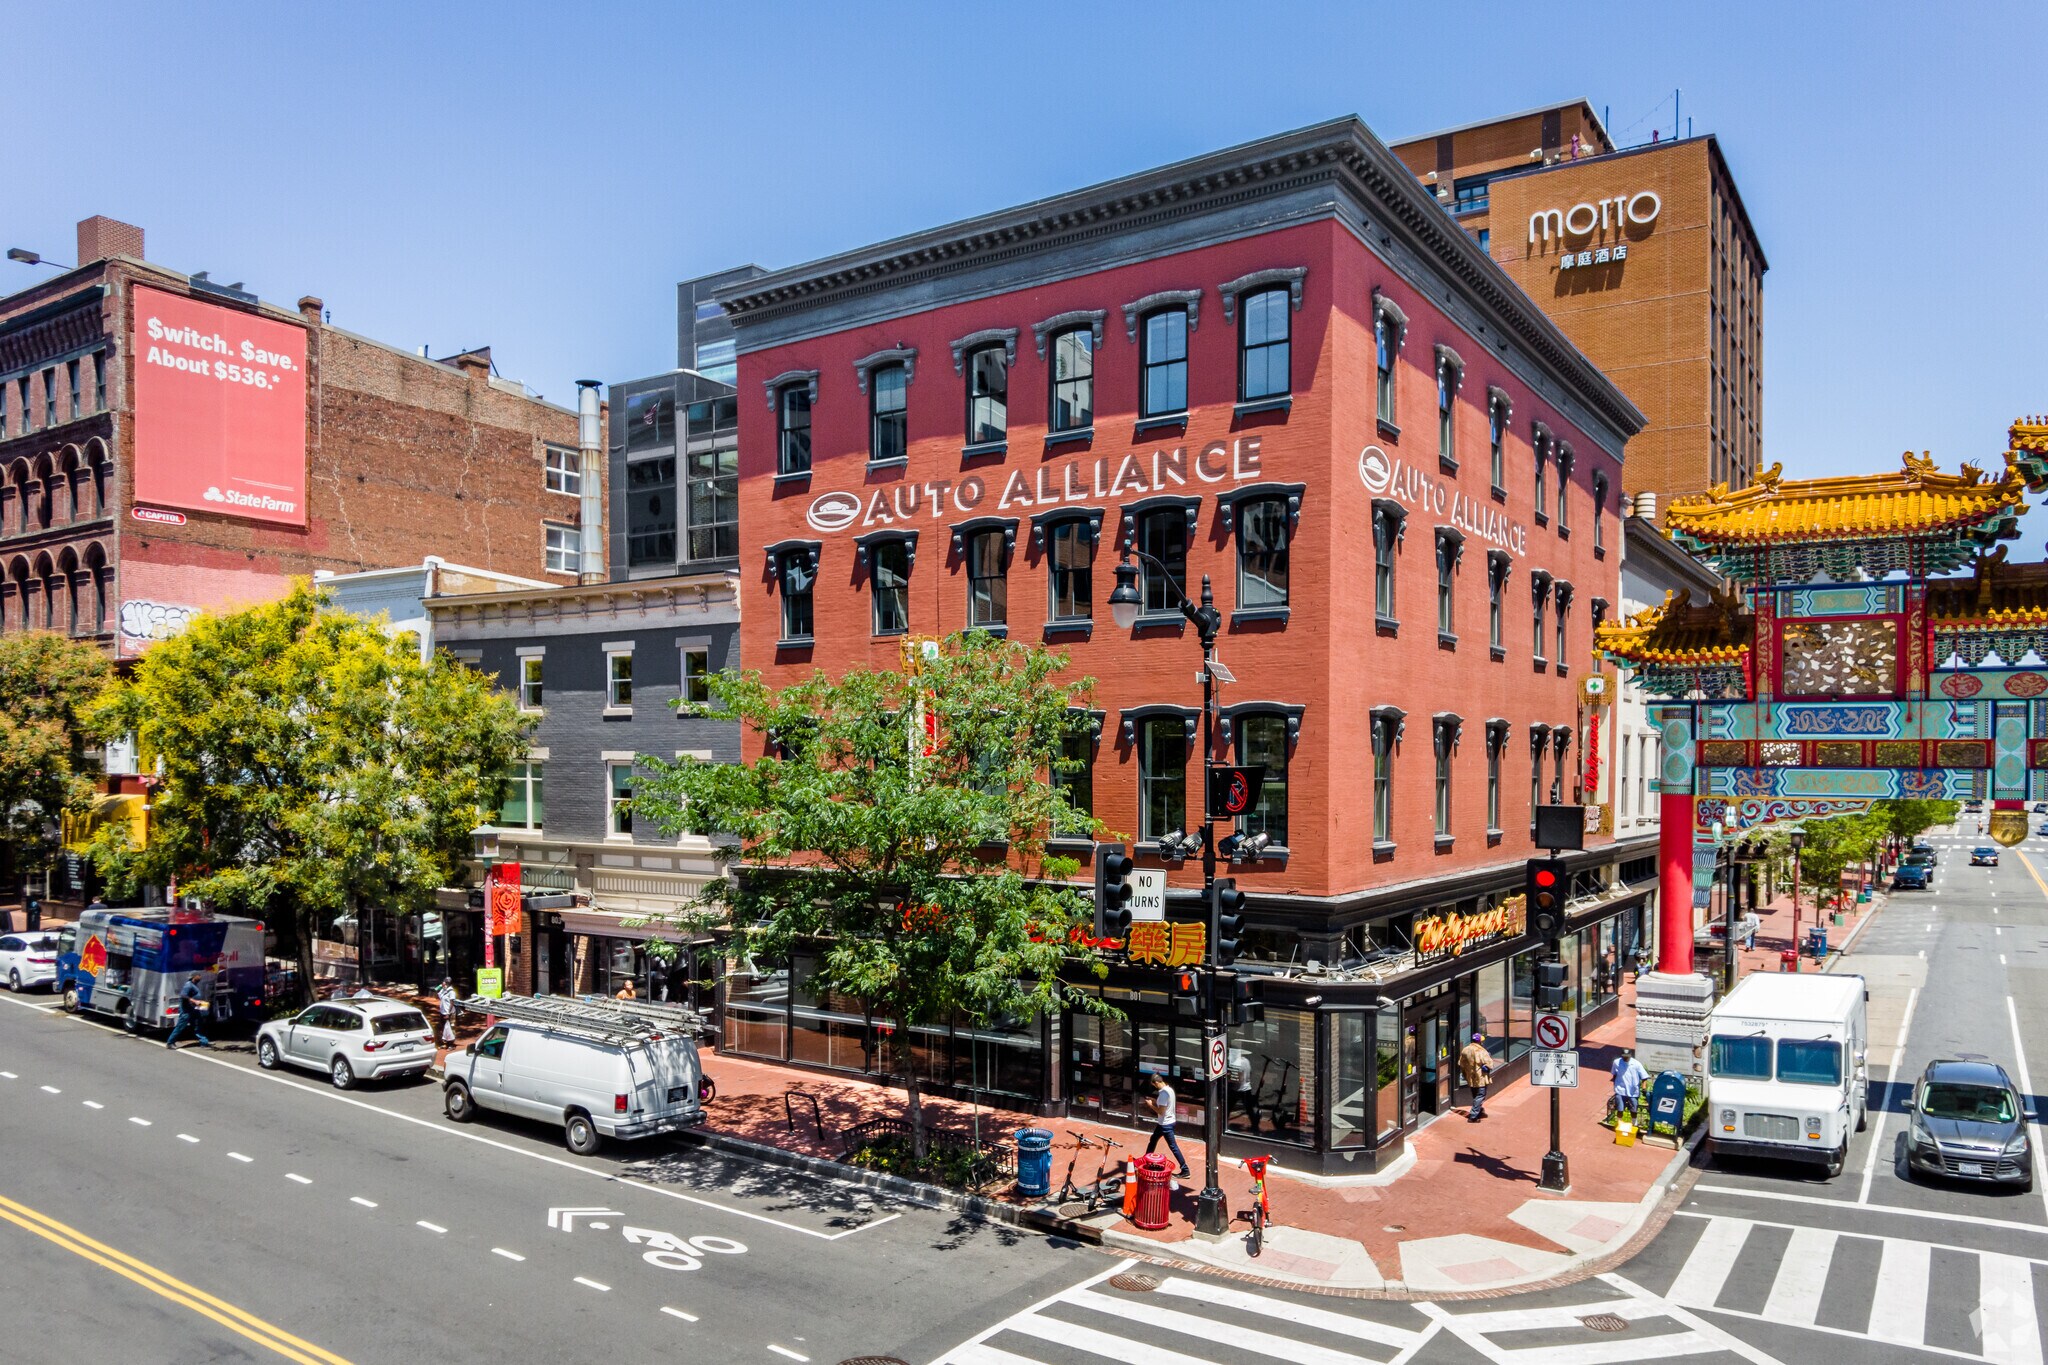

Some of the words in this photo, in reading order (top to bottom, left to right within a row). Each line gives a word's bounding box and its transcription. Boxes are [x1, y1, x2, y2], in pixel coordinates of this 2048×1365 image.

[1529, 191, 1661, 243] MOTTO
[1560, 245, 1627, 270] 摩庭酒店
[147, 316, 234, 356] $witch.
[240, 339, 298, 371] $ave.
[147, 346, 210, 376] About
[862, 475, 985, 527] AUTO
[997, 435, 1262, 509] ALLIANCE
[145, 510, 181, 523] CAPITOL
[1390, 459, 1447, 515] AUTO
[1450, 491, 1526, 557] ALLIANCE
[1584, 713, 1603, 792] Walgreens
[1138, 875, 1152, 888] NO
[1129, 896, 1159, 908] TURNS
[1413, 905, 1507, 956] Walgreens
[1130, 990, 1140, 1001] 801
